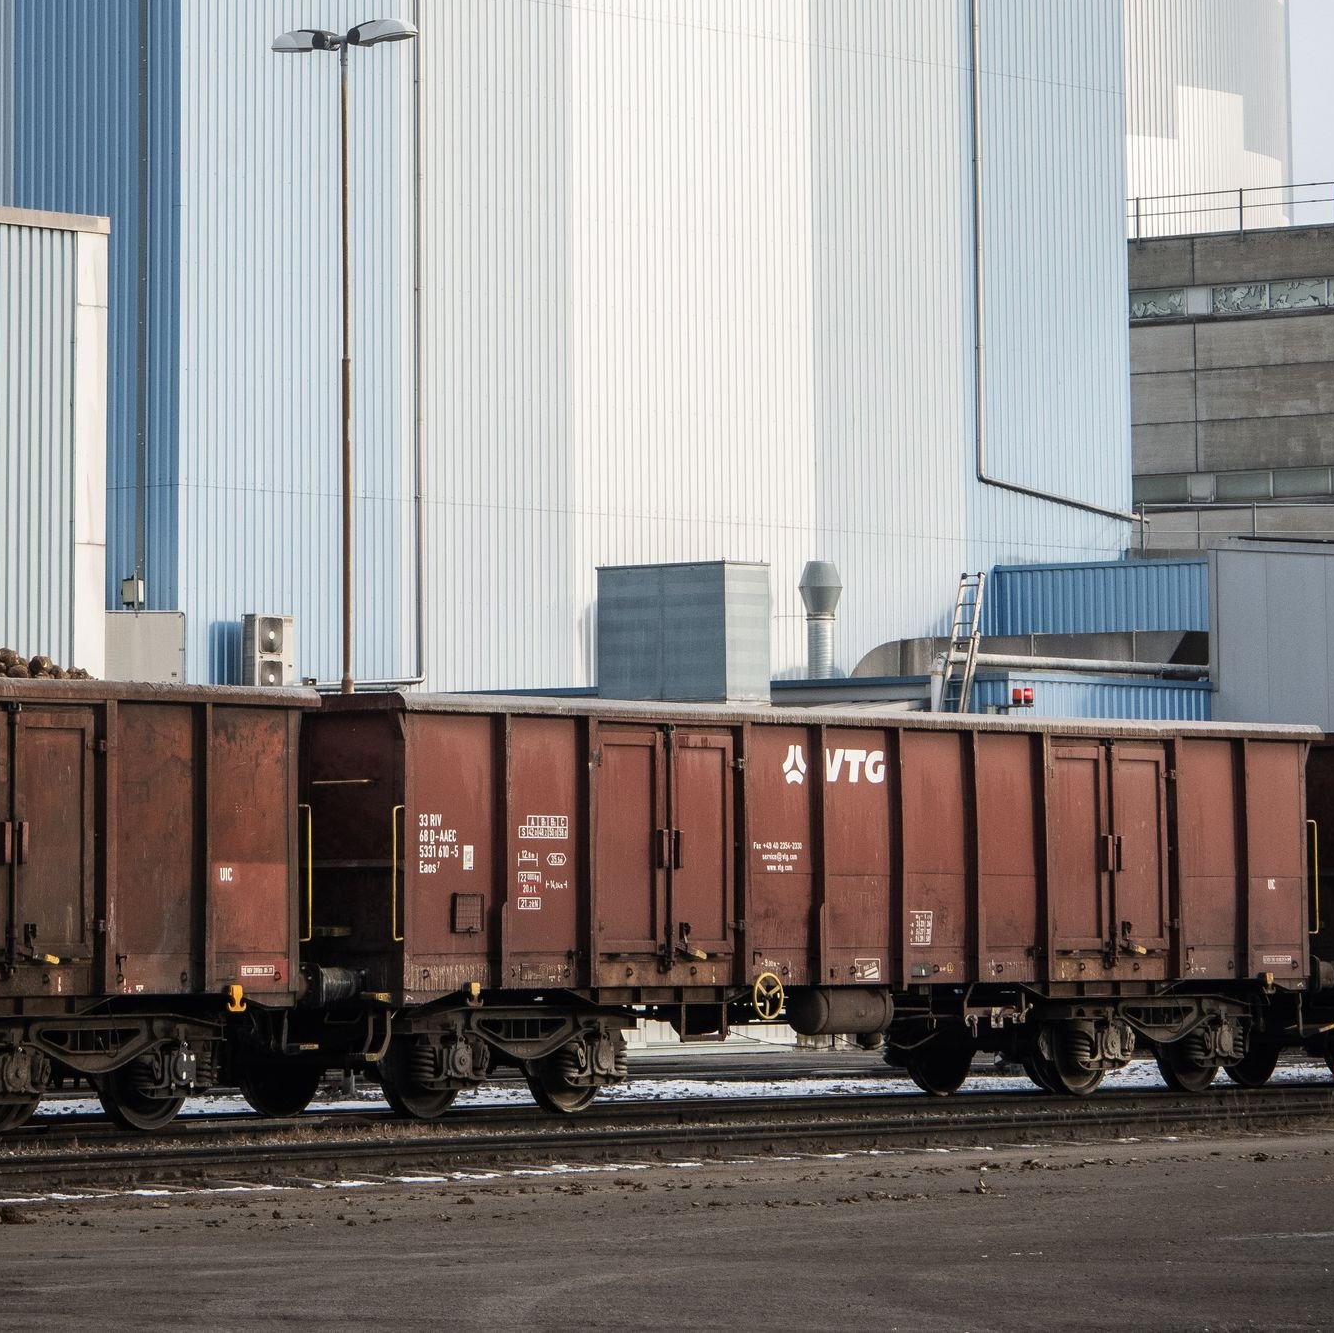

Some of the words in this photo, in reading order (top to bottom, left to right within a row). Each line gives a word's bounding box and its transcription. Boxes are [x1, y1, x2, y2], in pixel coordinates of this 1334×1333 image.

[825, 748, 885, 784] VTG
[419, 814, 429, 827] 33
[430, 814, 442, 827] RIV
[419, 830, 429, 842] 68
[430, 830, 457, 844] D-AAEC
[419, 845, 436, 858] 5331
[219, 867, 233, 881] UIC
